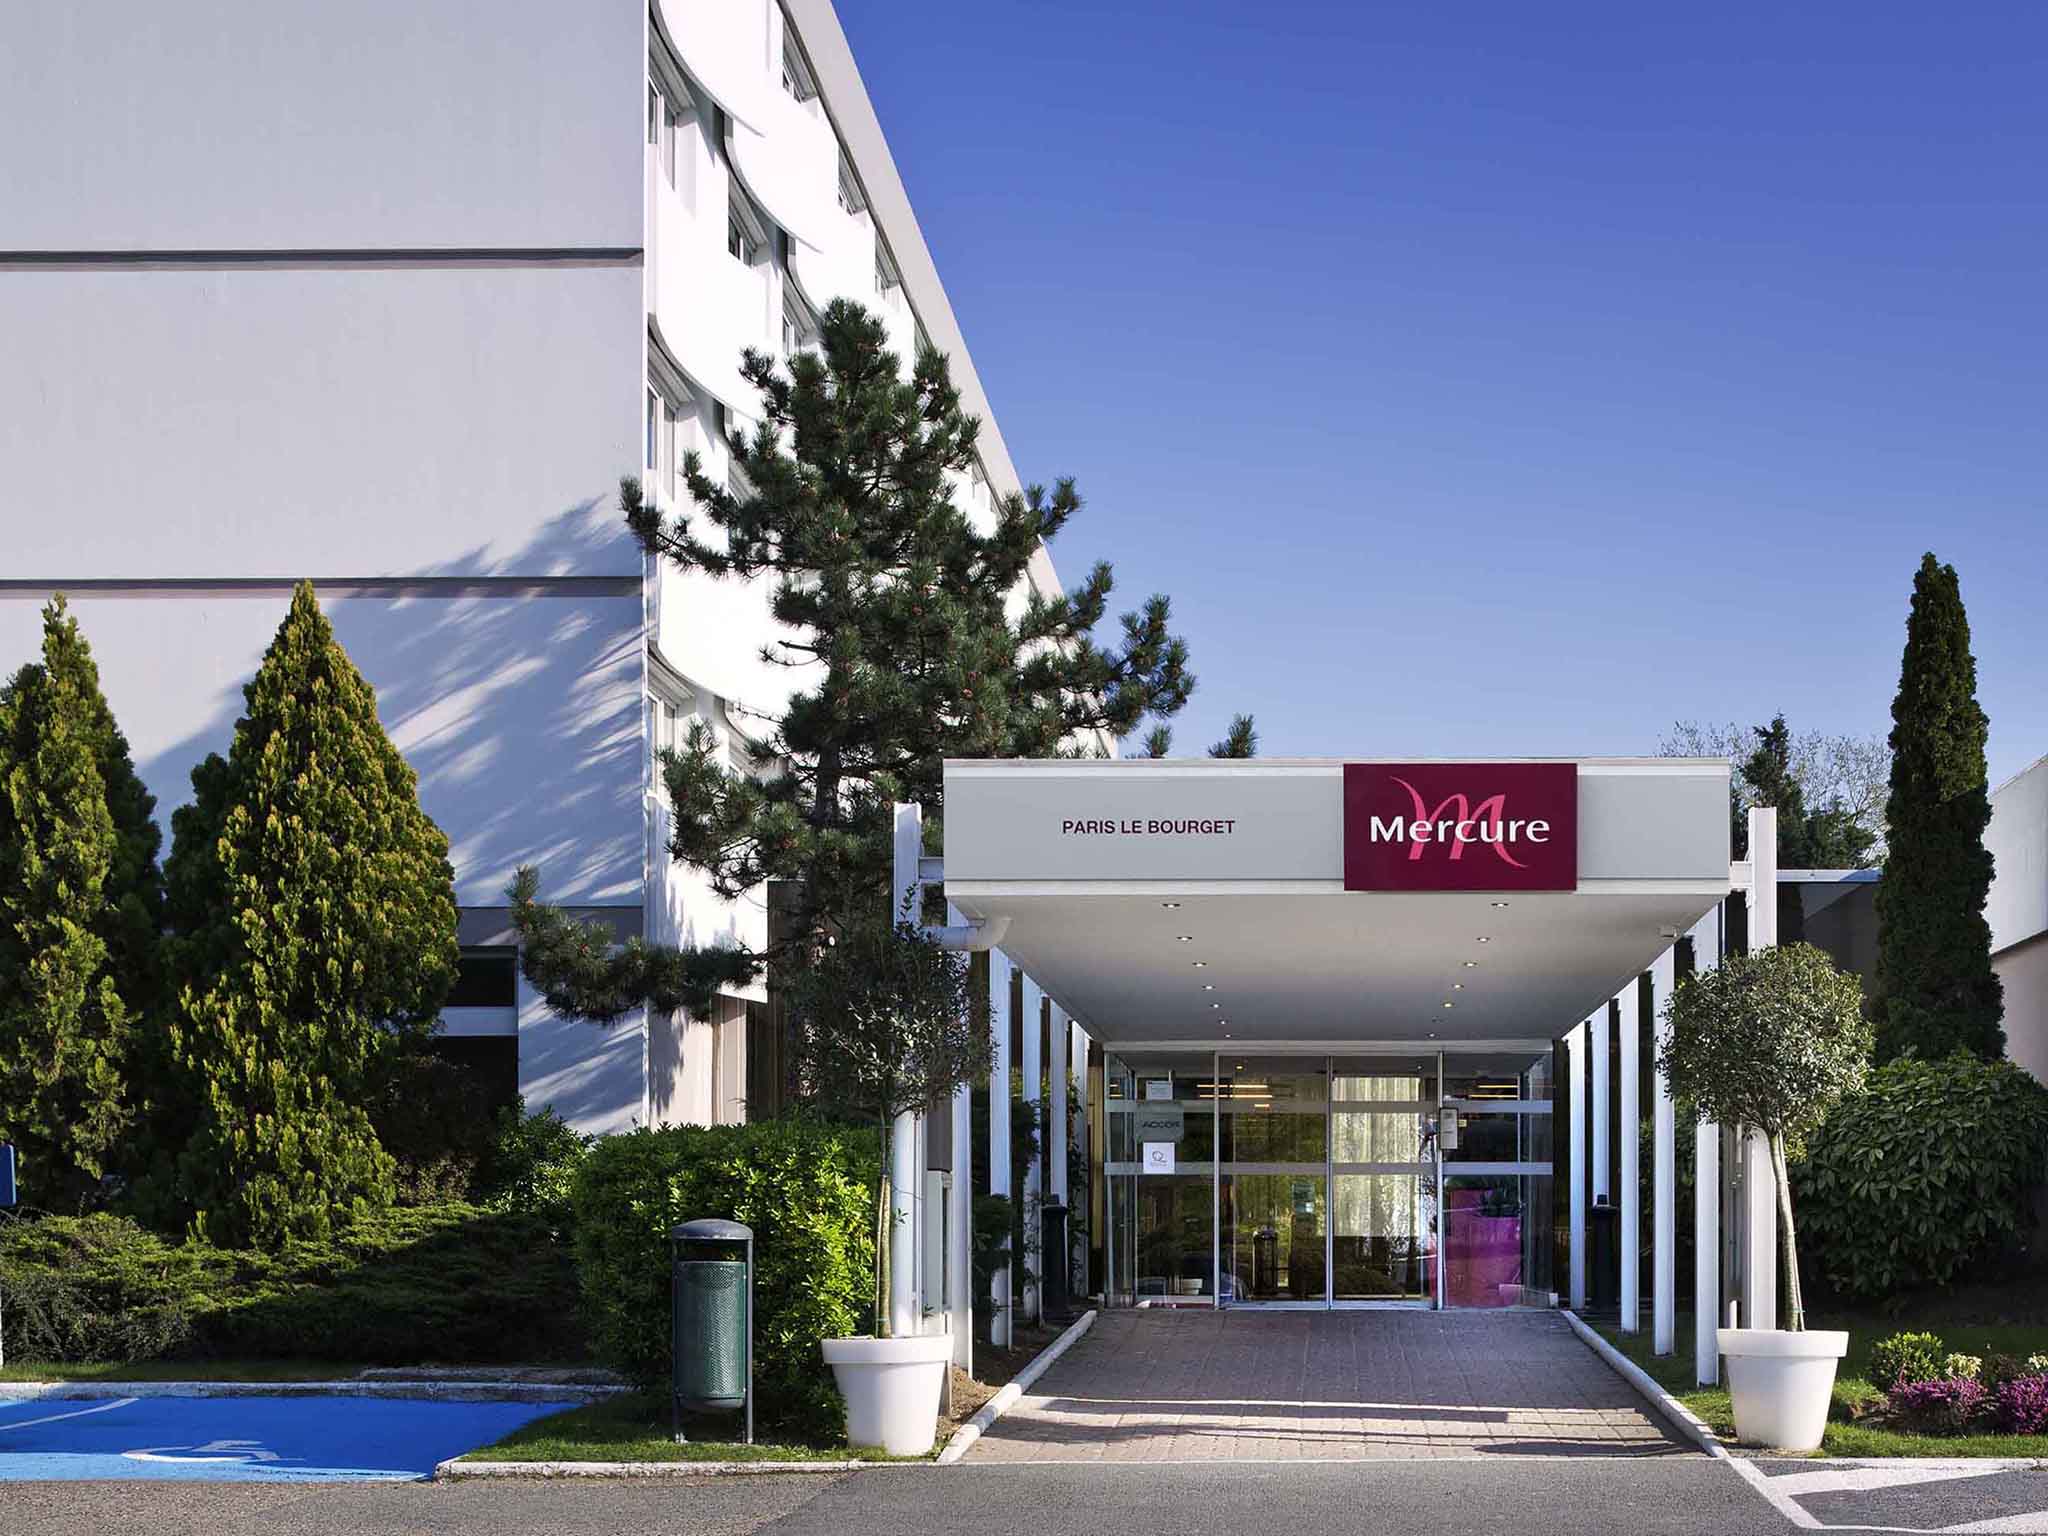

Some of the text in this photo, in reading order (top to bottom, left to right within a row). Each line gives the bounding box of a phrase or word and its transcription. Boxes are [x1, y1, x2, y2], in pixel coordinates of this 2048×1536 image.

[1062, 820, 1235, 834] PARIS LE BOURGET
[1370, 815, 1550, 842] Mercure
